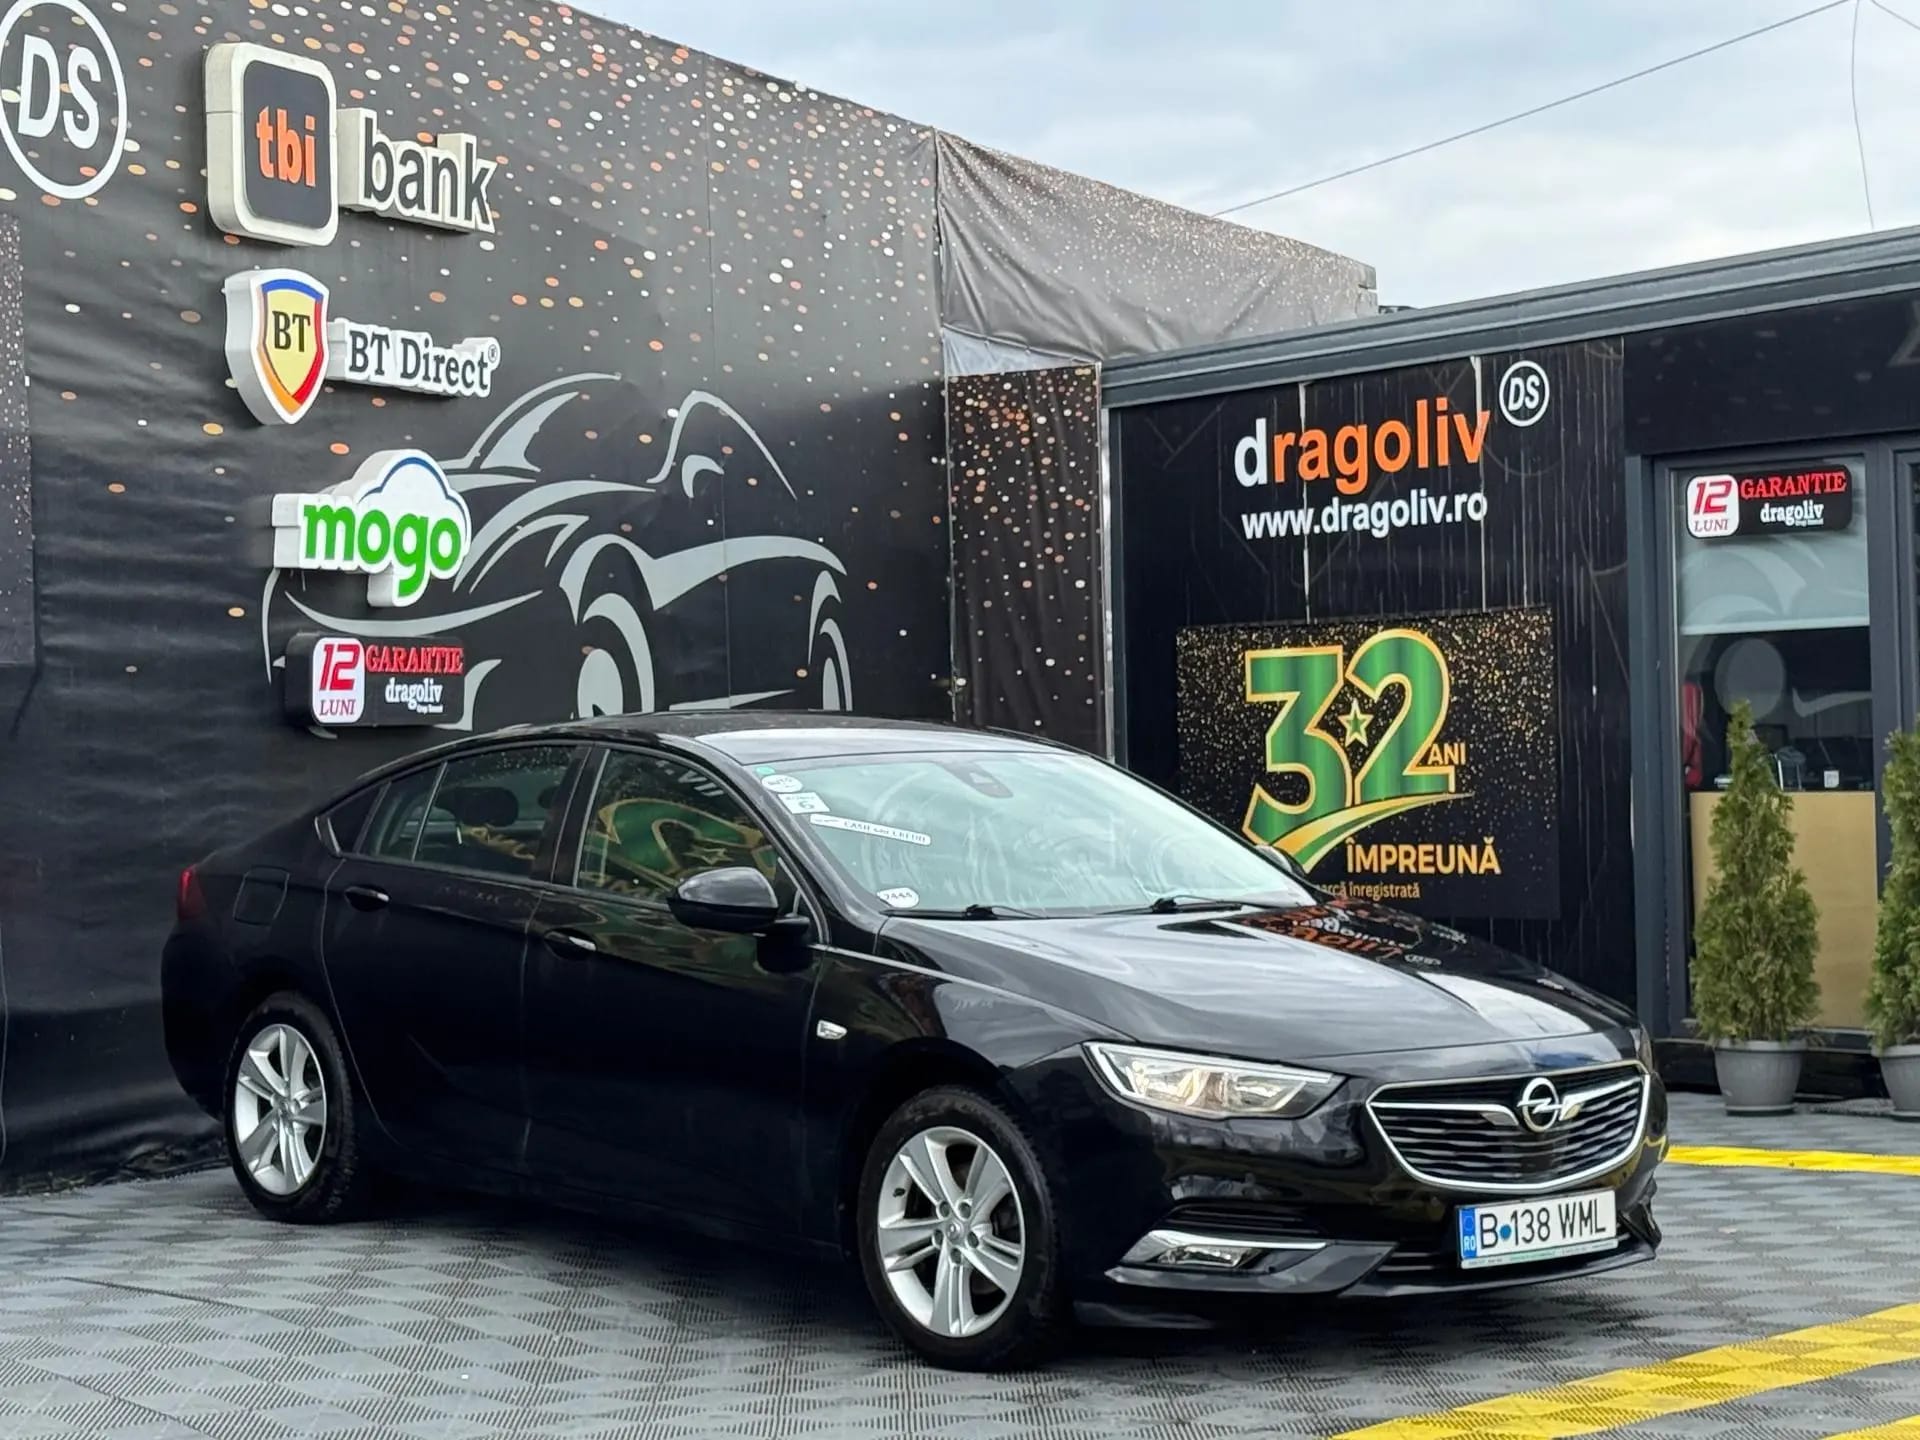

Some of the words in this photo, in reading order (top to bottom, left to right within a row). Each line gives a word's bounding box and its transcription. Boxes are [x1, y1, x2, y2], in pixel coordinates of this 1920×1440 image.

[18, 34, 101, 149] DS
[256, 106, 316, 188] tbi
[364, 117, 490, 226] bank
[272, 310, 311, 352] BT
[349, 330, 390, 376] BT
[1508, 374, 1541, 411] DS
[1234, 397, 1491, 494] dragoliv
[1693, 480, 1732, 515] 12
[1740, 471, 1847, 500] GARANTIE
[1241, 489, 1488, 539] www.dragoliv.ro
[1694, 518, 1729, 532] LUNI
[1760, 499, 1824, 526] dragoliv
[303, 503, 462, 599] mogo
[319, 643, 361, 691] 12
[365, 644, 464, 674] GARANTIE
[319, 699, 356, 716] LUNI
[385, 676, 443, 710] dragoliv
[1242, 628, 1456, 846] 32
[1427, 742, 1466, 766] ANI
[1345, 836, 1502, 875] ÎMPREUNĂ
[1349, 881, 1421, 901] înregistrată
[1463, 1235, 1476, 1251] RO
[1480, 1213, 1498, 1249] B
[1510, 1207, 1550, 1246] 138
[1558, 1198, 1606, 1240] WML
